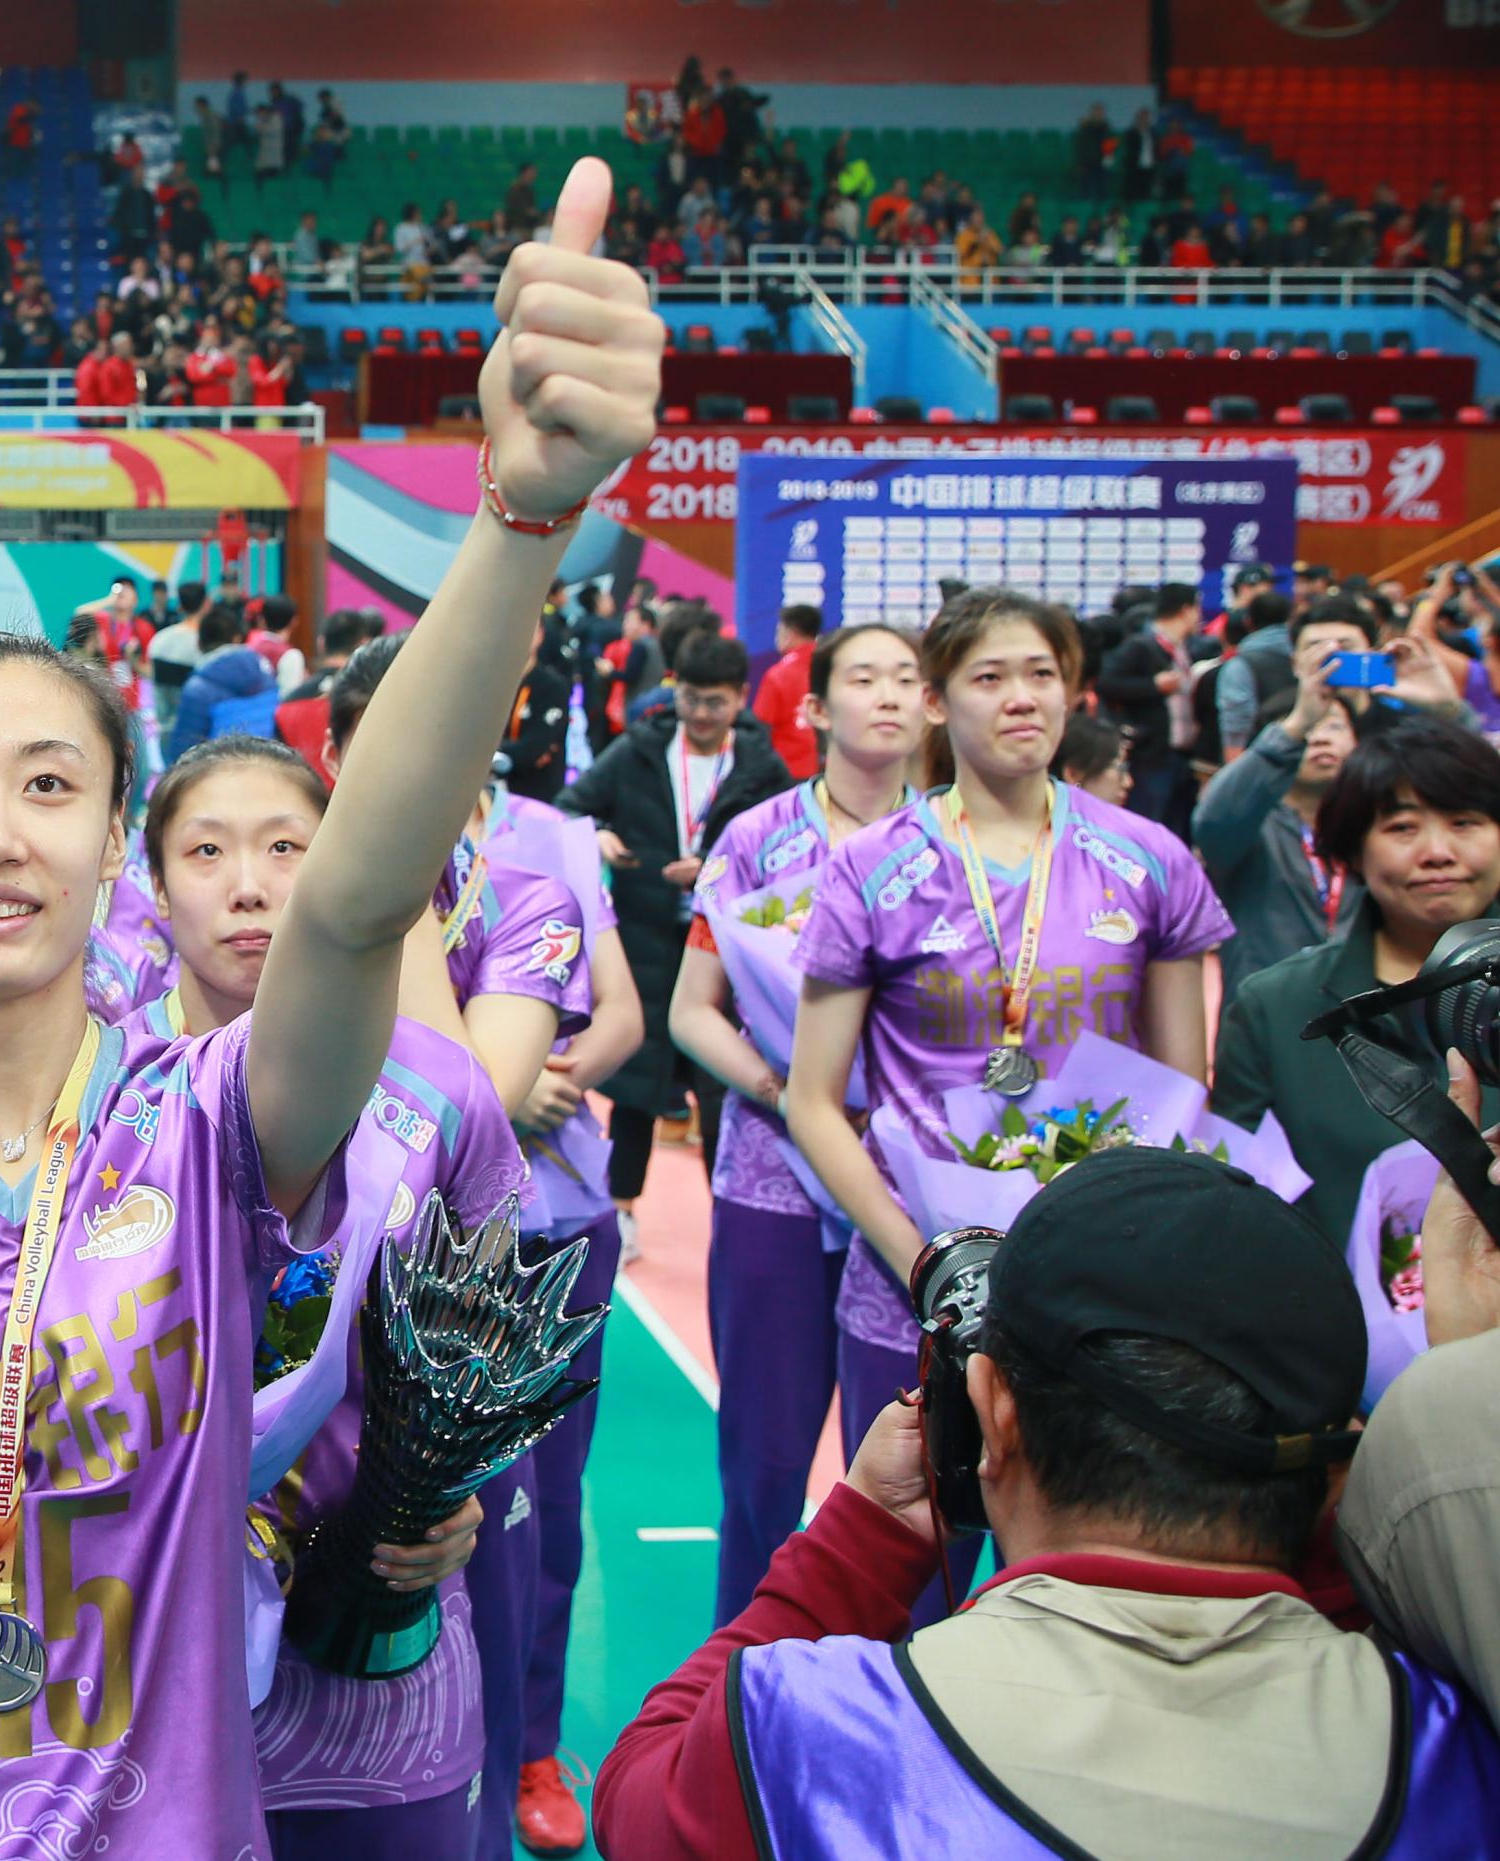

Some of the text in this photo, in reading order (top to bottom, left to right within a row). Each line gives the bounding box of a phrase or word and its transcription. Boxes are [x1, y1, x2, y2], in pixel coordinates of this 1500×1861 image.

[647, 435, 740, 472] 2018
[646, 483, 740, 520] 2018
[15, 1141, 67, 1325] China Volleyball League
